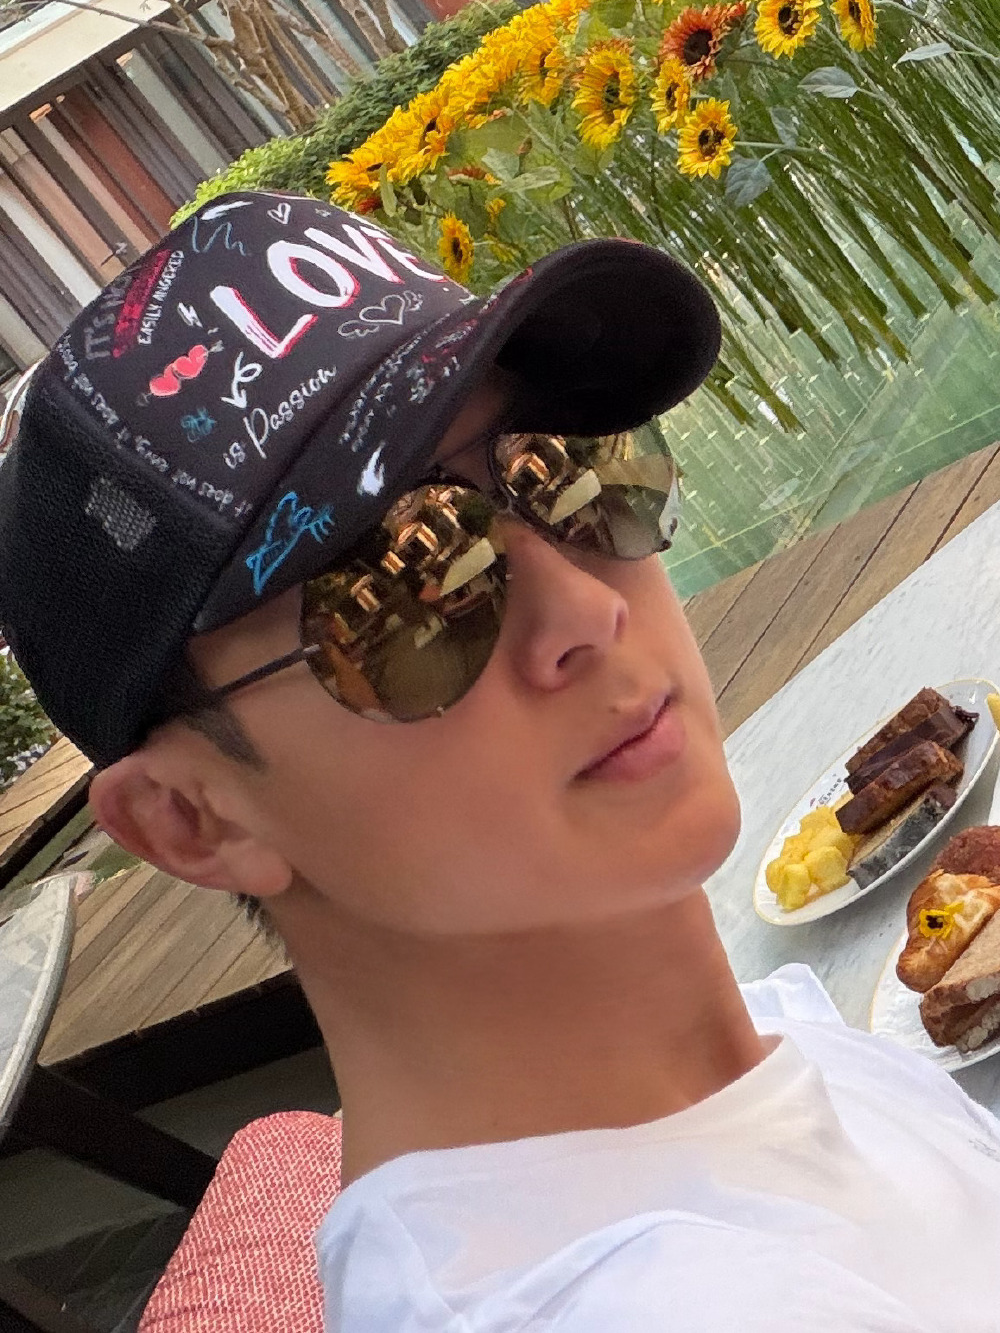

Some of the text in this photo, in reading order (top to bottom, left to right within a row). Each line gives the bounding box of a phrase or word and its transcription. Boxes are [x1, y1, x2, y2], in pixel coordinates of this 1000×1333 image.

[137, 250, 185, 345] EASILY ANGERED
[210, 223, 449, 359] LOVE
[223, 441, 247, 470] is
[243, 365, 338, 460] Passion
[198, 482, 234, 512] does
